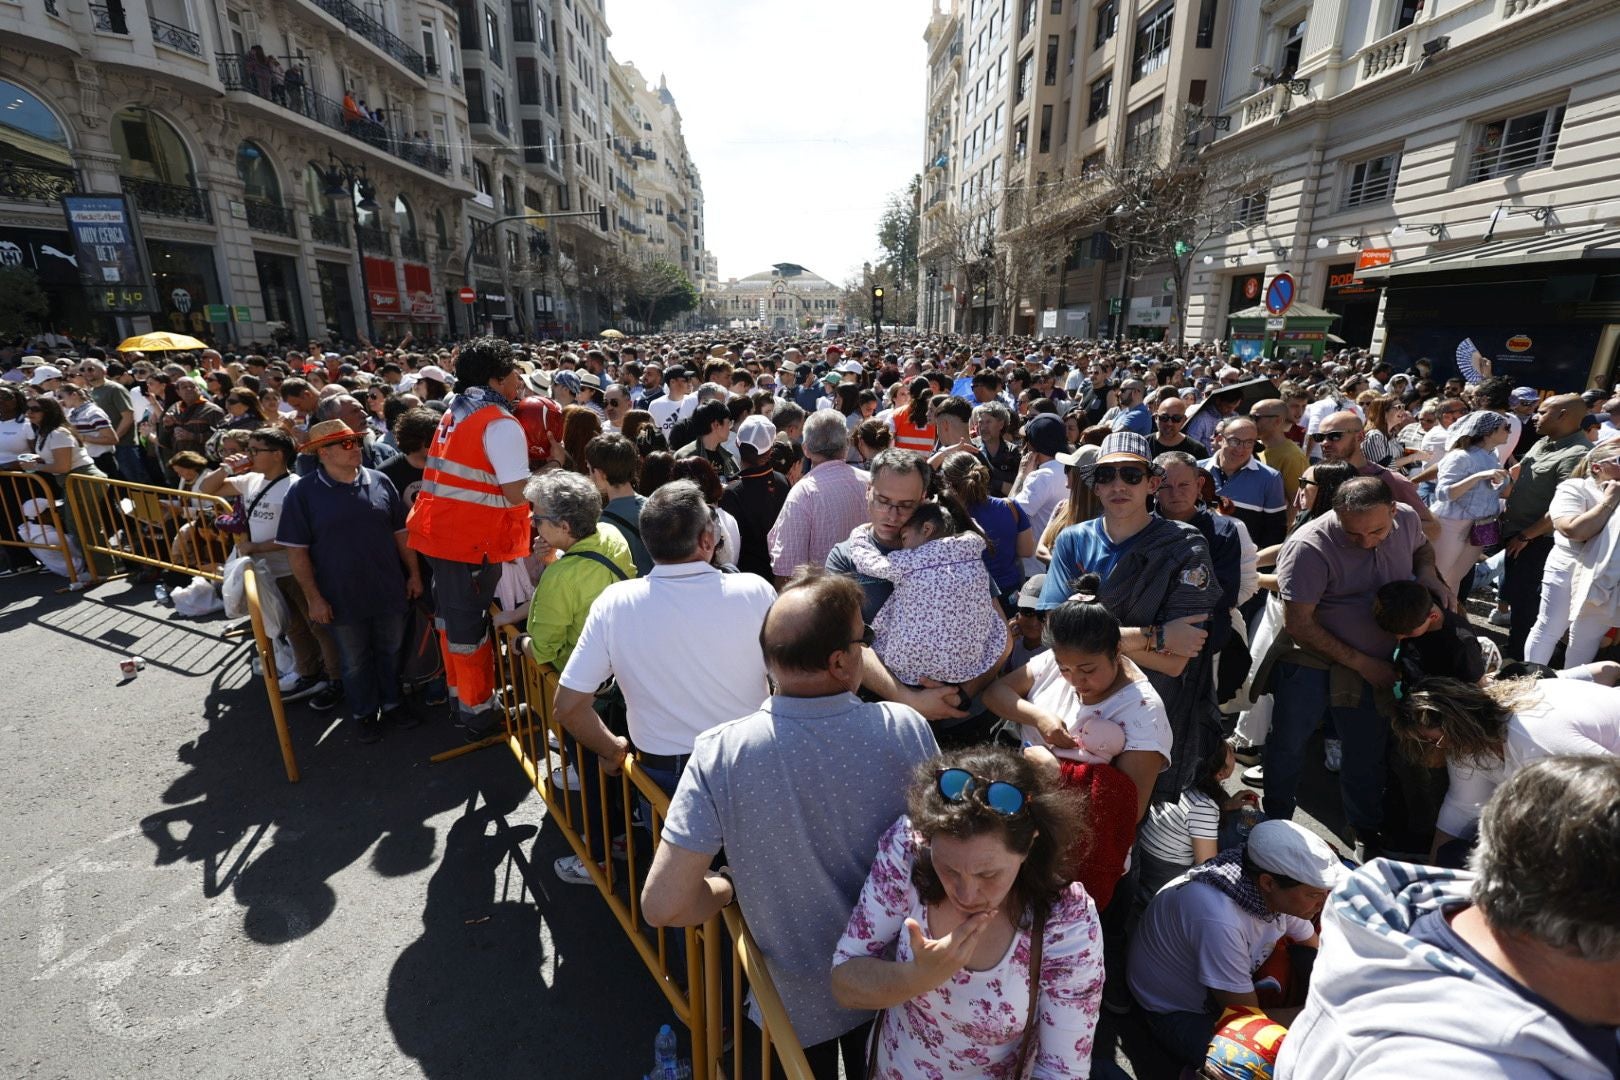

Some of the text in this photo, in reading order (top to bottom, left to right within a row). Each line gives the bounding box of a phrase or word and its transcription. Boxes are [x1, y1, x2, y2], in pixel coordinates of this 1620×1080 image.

[79, 227, 125, 243] MUY CERCA
[96, 245, 118, 261] DE TI
[253, 509, 274, 520] BOSS
